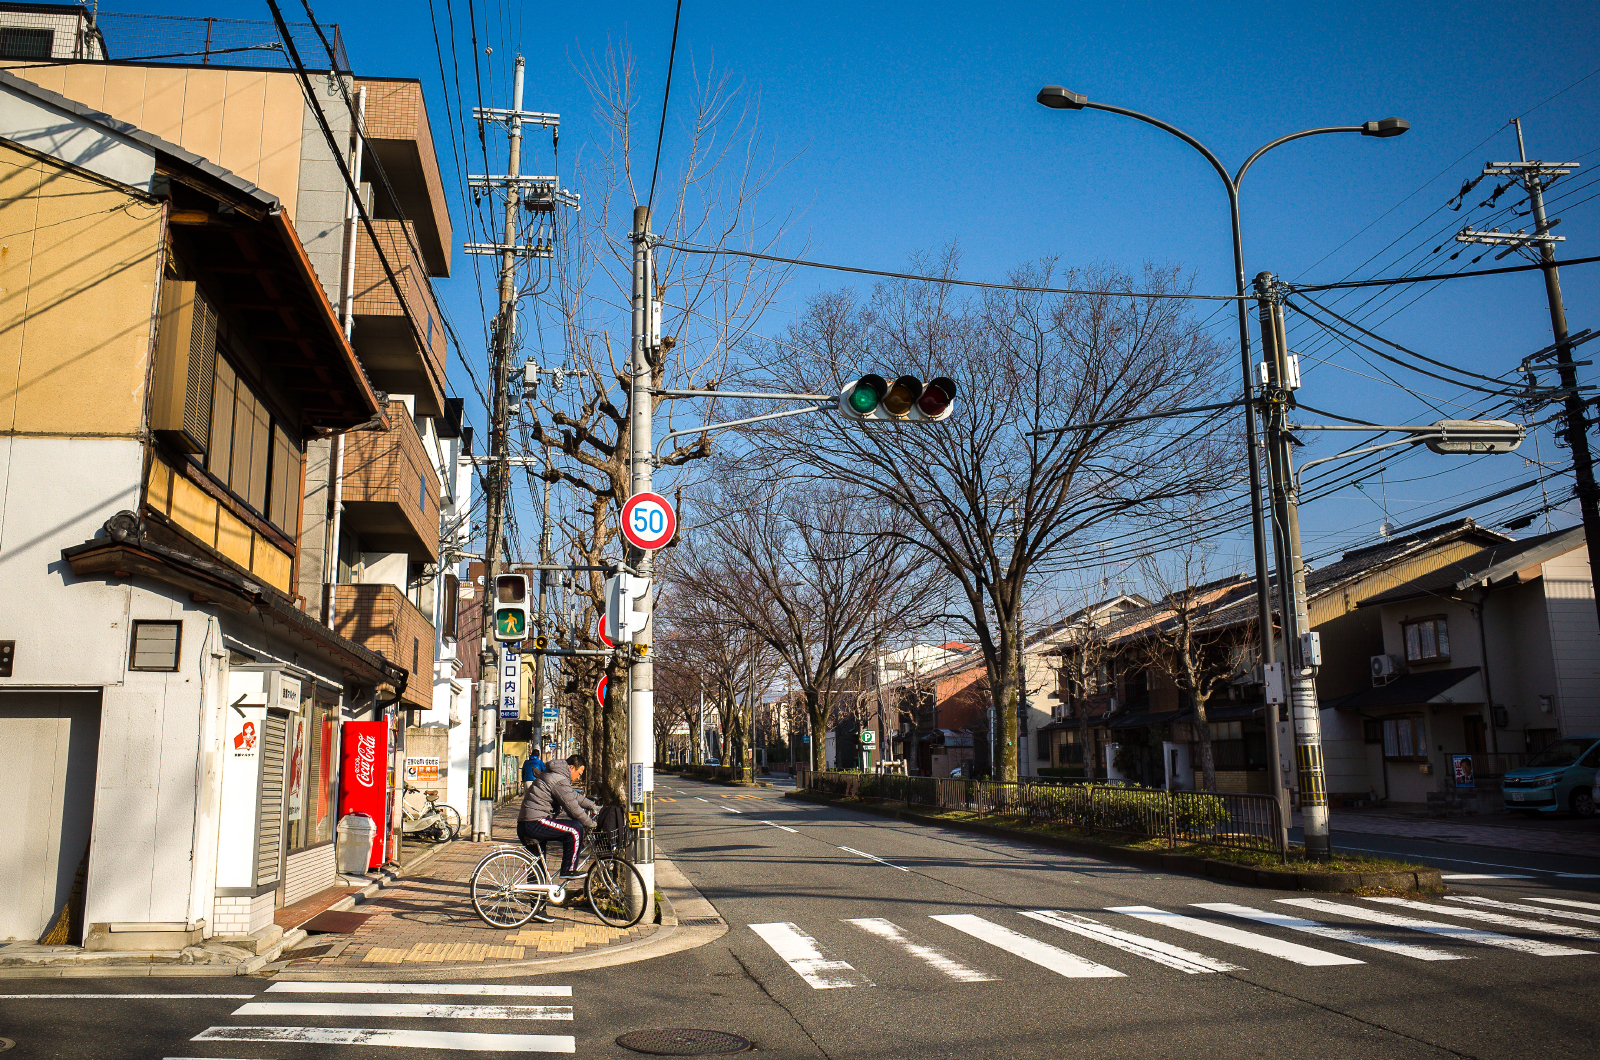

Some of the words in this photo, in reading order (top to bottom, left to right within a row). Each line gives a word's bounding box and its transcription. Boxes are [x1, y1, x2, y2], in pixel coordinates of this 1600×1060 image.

[634, 508, 663, 533] 50
[503, 651, 517, 709] 出口内科
[356, 732, 376, 787] Coca-Cola
